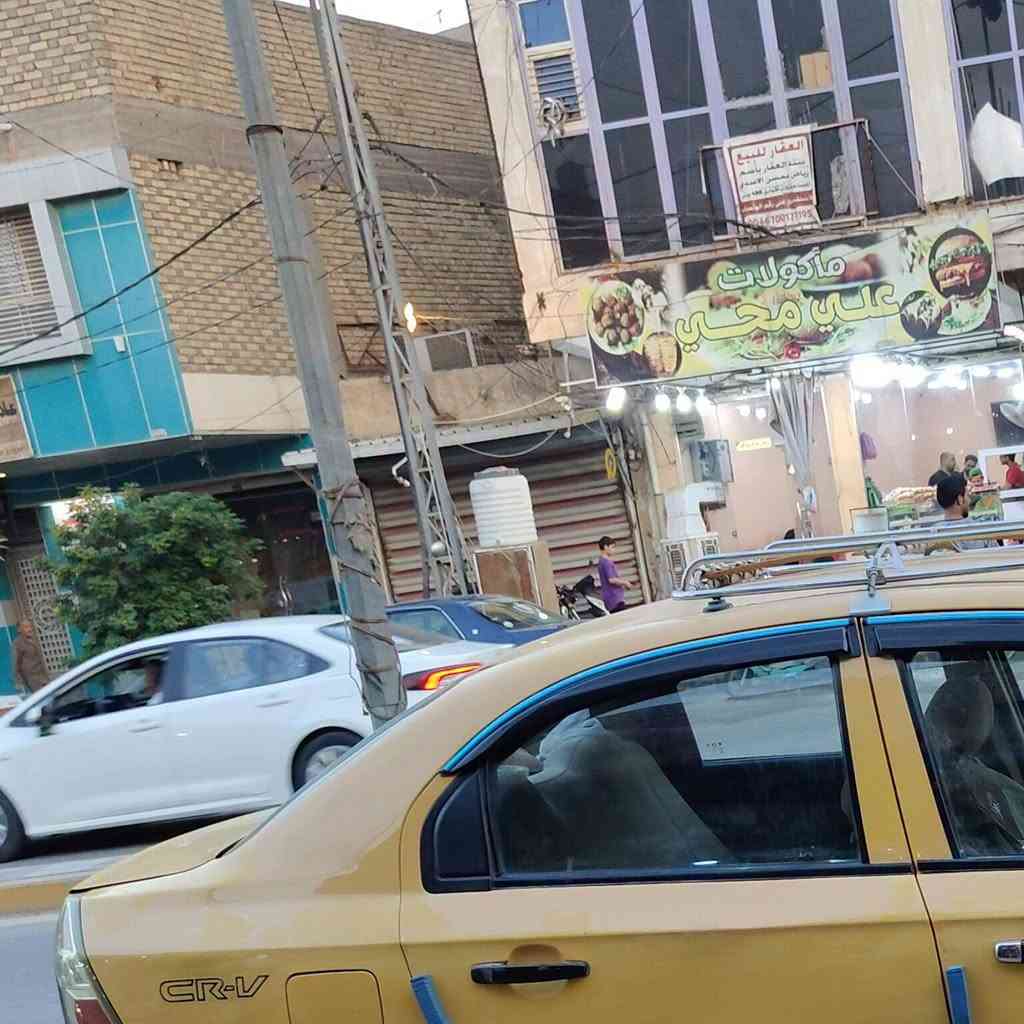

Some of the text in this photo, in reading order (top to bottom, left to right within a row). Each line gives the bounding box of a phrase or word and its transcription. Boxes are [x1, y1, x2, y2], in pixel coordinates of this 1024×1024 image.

[736, 146, 767, 166] للبيع
[768, 139, 806, 160] العقار
[717, 246, 846, 291] مأكولات
[675, 283, 901, 352] علي محي
[160, 975, 270, 1003] CR-V
